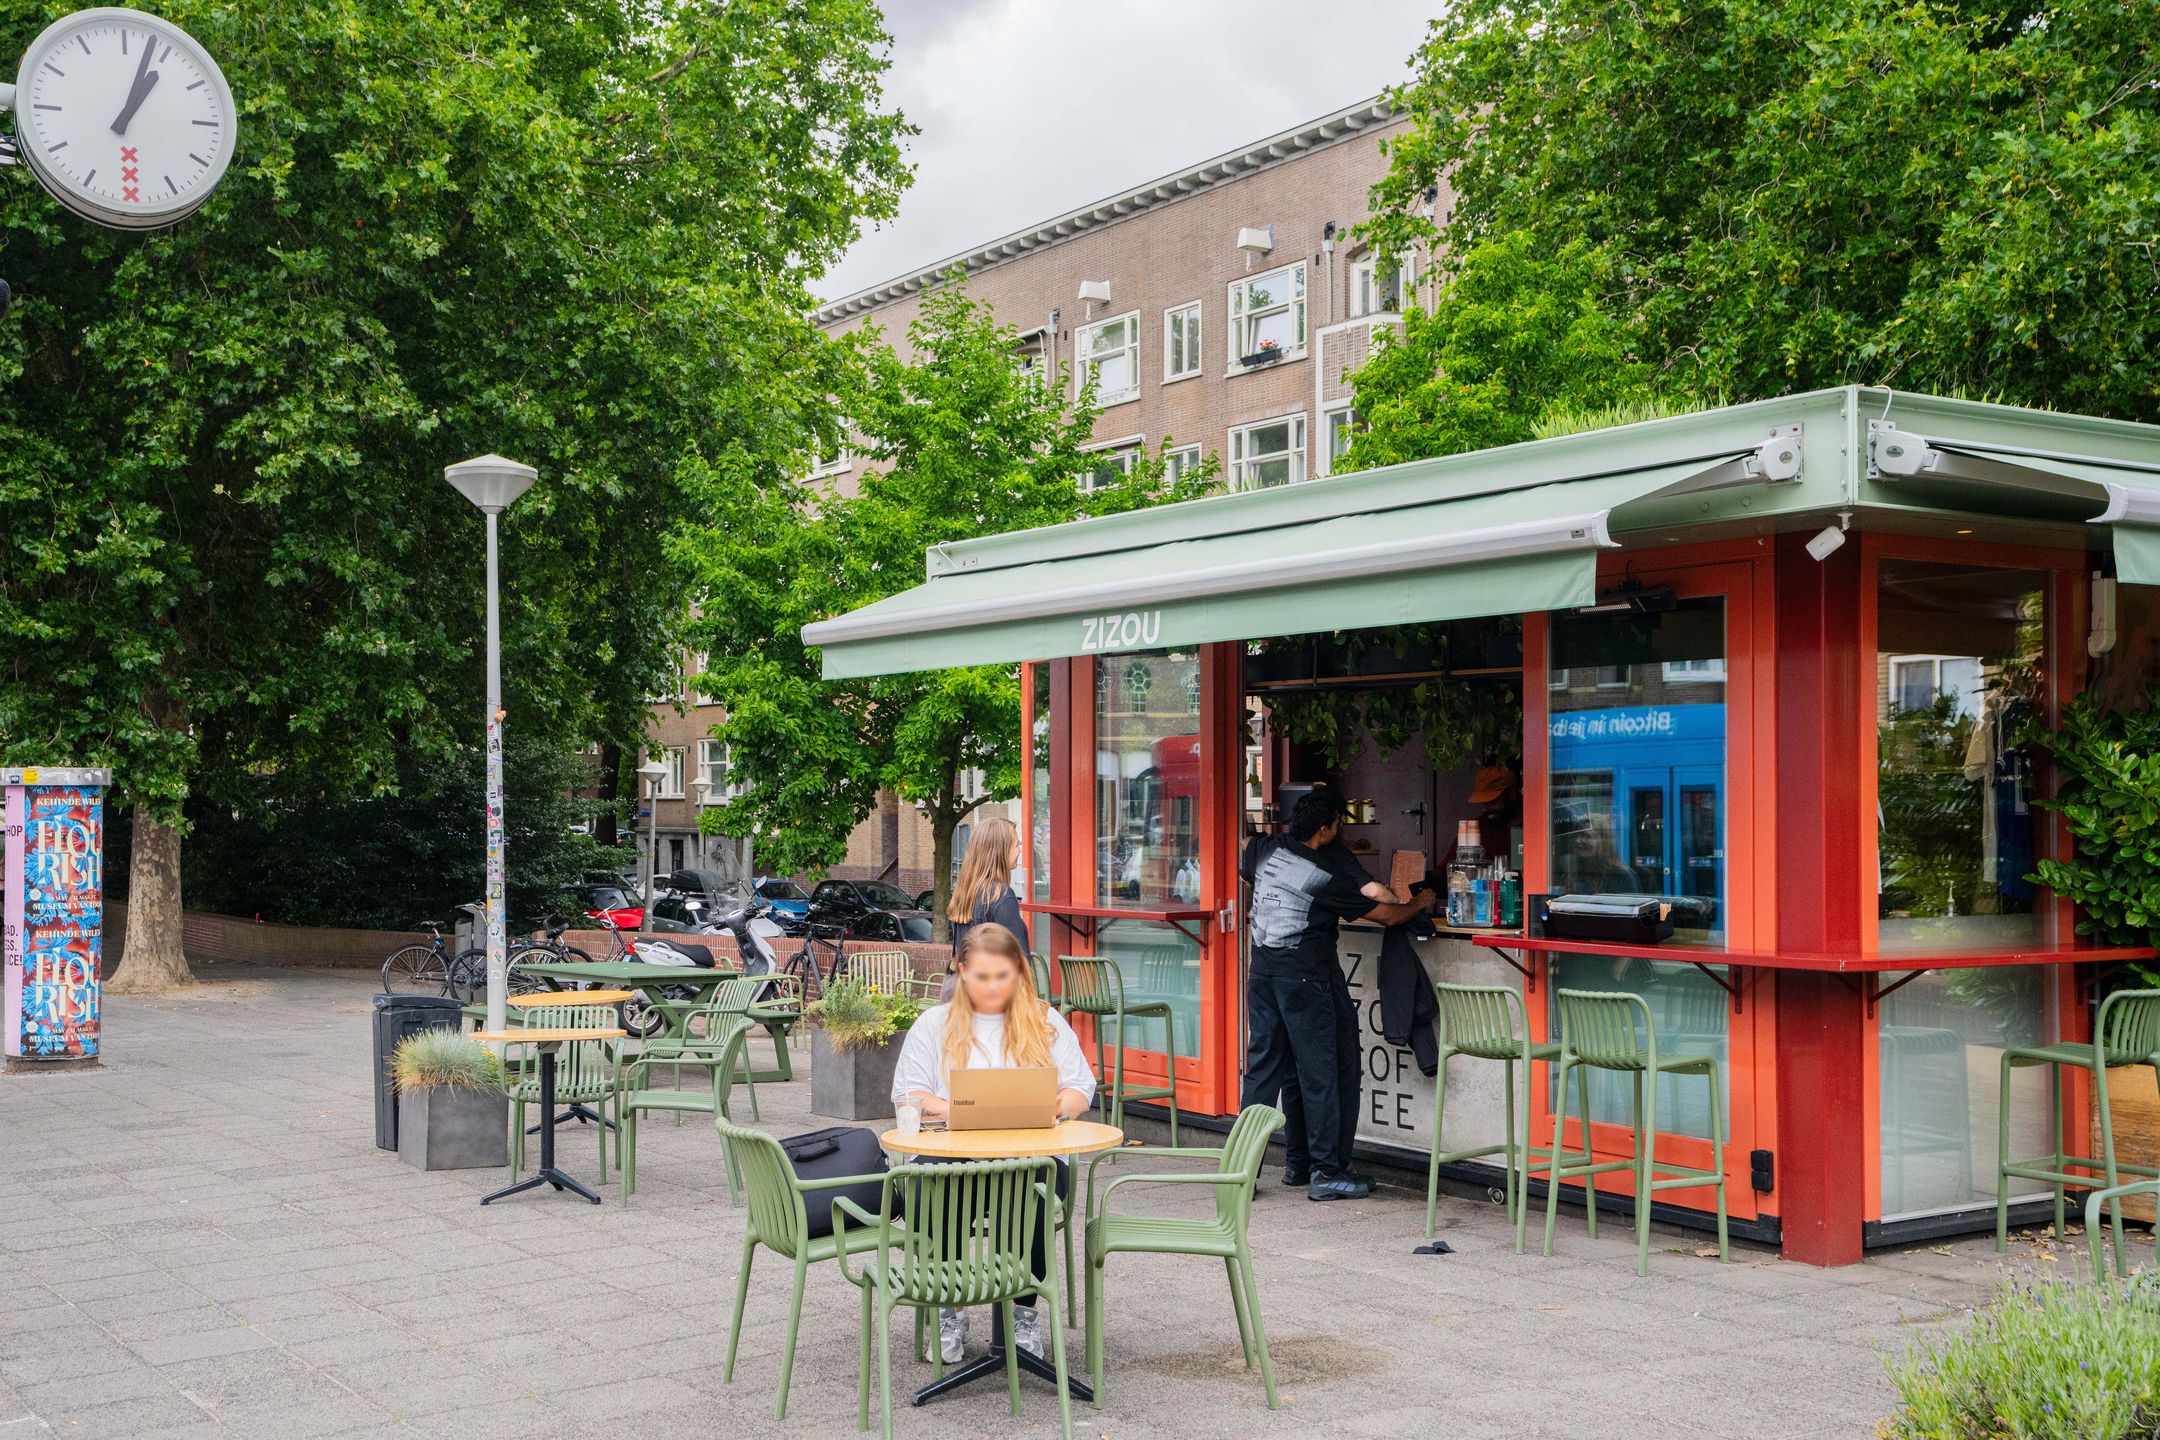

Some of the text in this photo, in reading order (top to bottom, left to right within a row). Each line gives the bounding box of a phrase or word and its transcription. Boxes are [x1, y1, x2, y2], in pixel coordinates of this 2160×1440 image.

[1082, 611, 1160, 650] ZIZOU
[37, 798, 80, 806] KEHINDE
[38, 850, 100, 890] RISH
[33, 902, 71, 910] MUSEUM
[36, 930, 80, 938] KEHINDE
[36, 982, 99, 1023] RISH
[29, 1035, 68, 1043] MUSEUM
[1360, 1045, 1413, 1083] OF
[1360, 1088, 1414, 1130] EE
